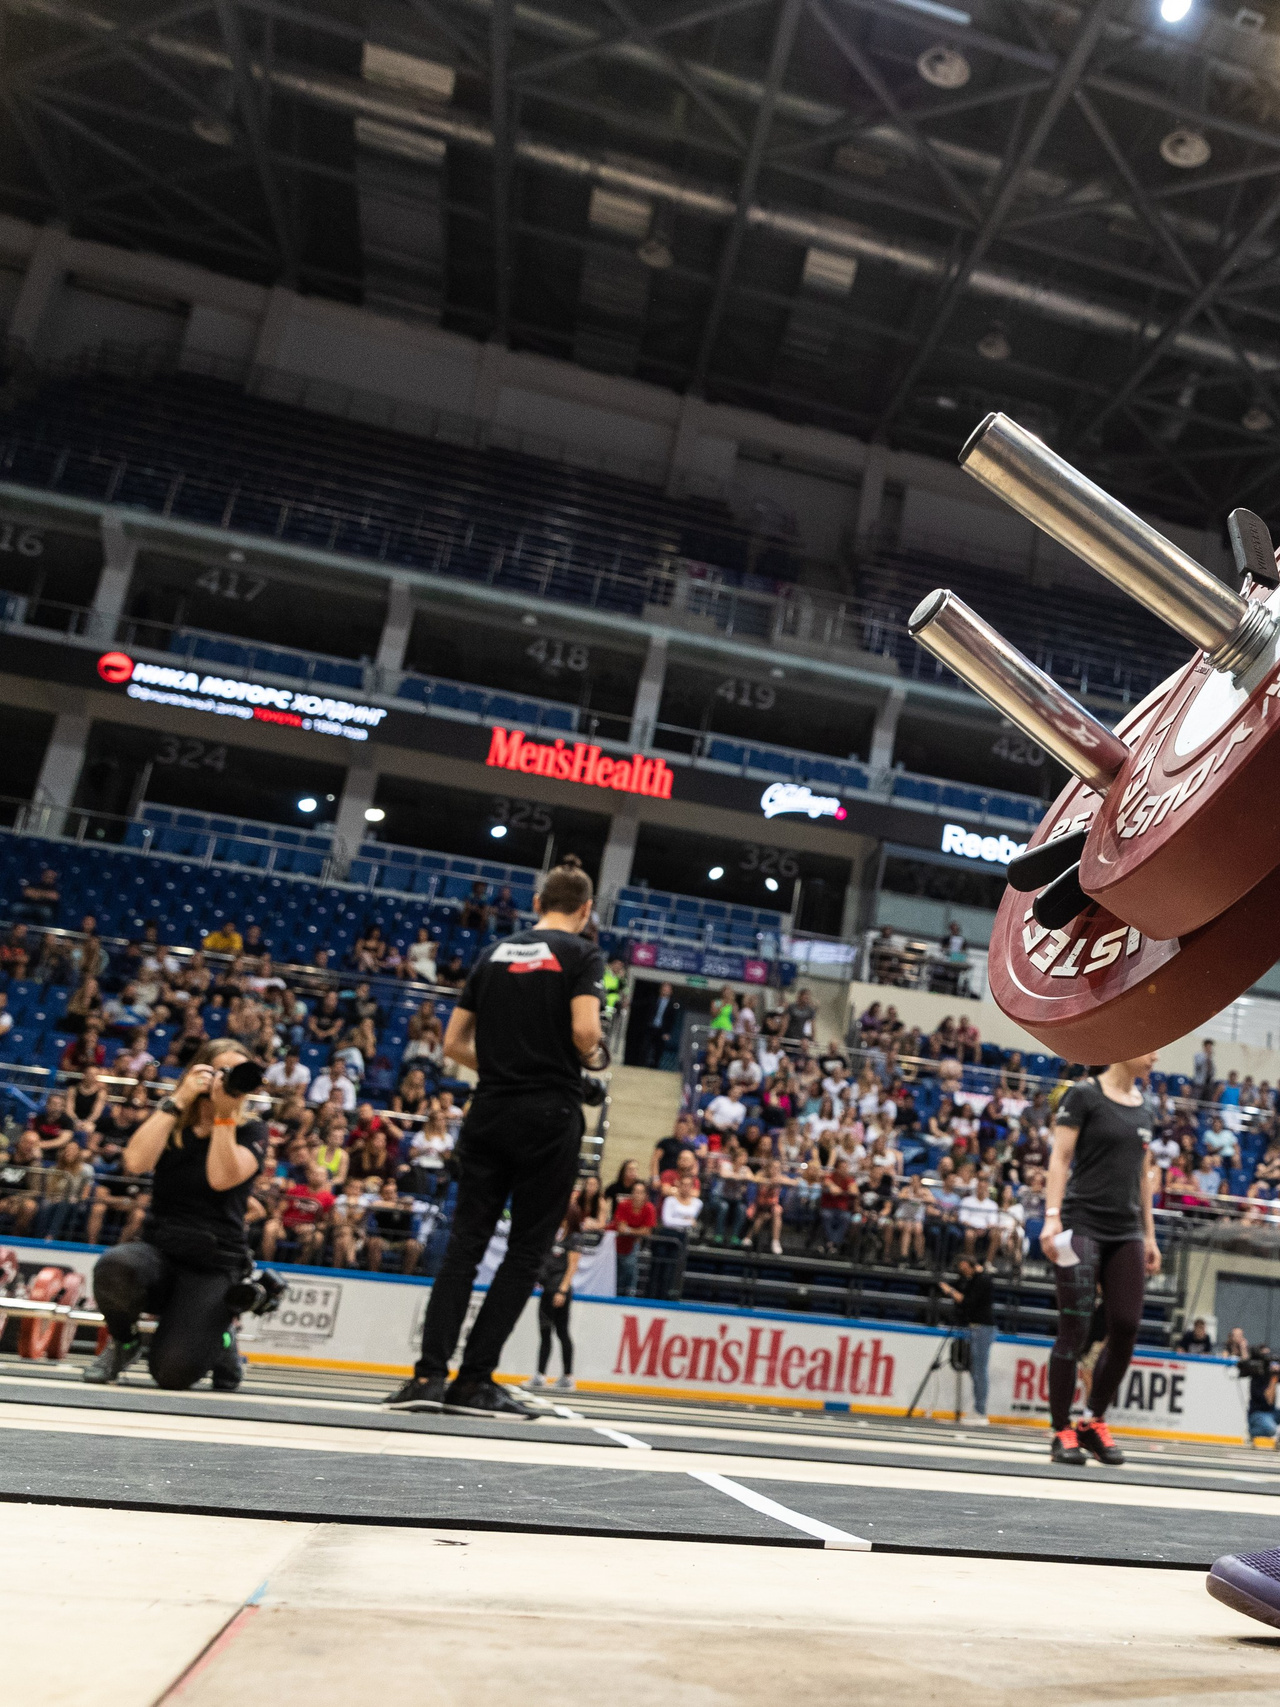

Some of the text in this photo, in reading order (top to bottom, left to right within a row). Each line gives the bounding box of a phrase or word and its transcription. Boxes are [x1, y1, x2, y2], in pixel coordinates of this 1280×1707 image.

[0, 524, 44, 557] 16
[196, 568, 267, 600] 417
[525, 637, 590, 672] 418
[716, 679, 776, 710] 419
[155, 736, 228, 772] 324
[991, 737, 1045, 766] 420
[739, 847, 799, 877] 326
[286, 1287, 334, 1308] UST
